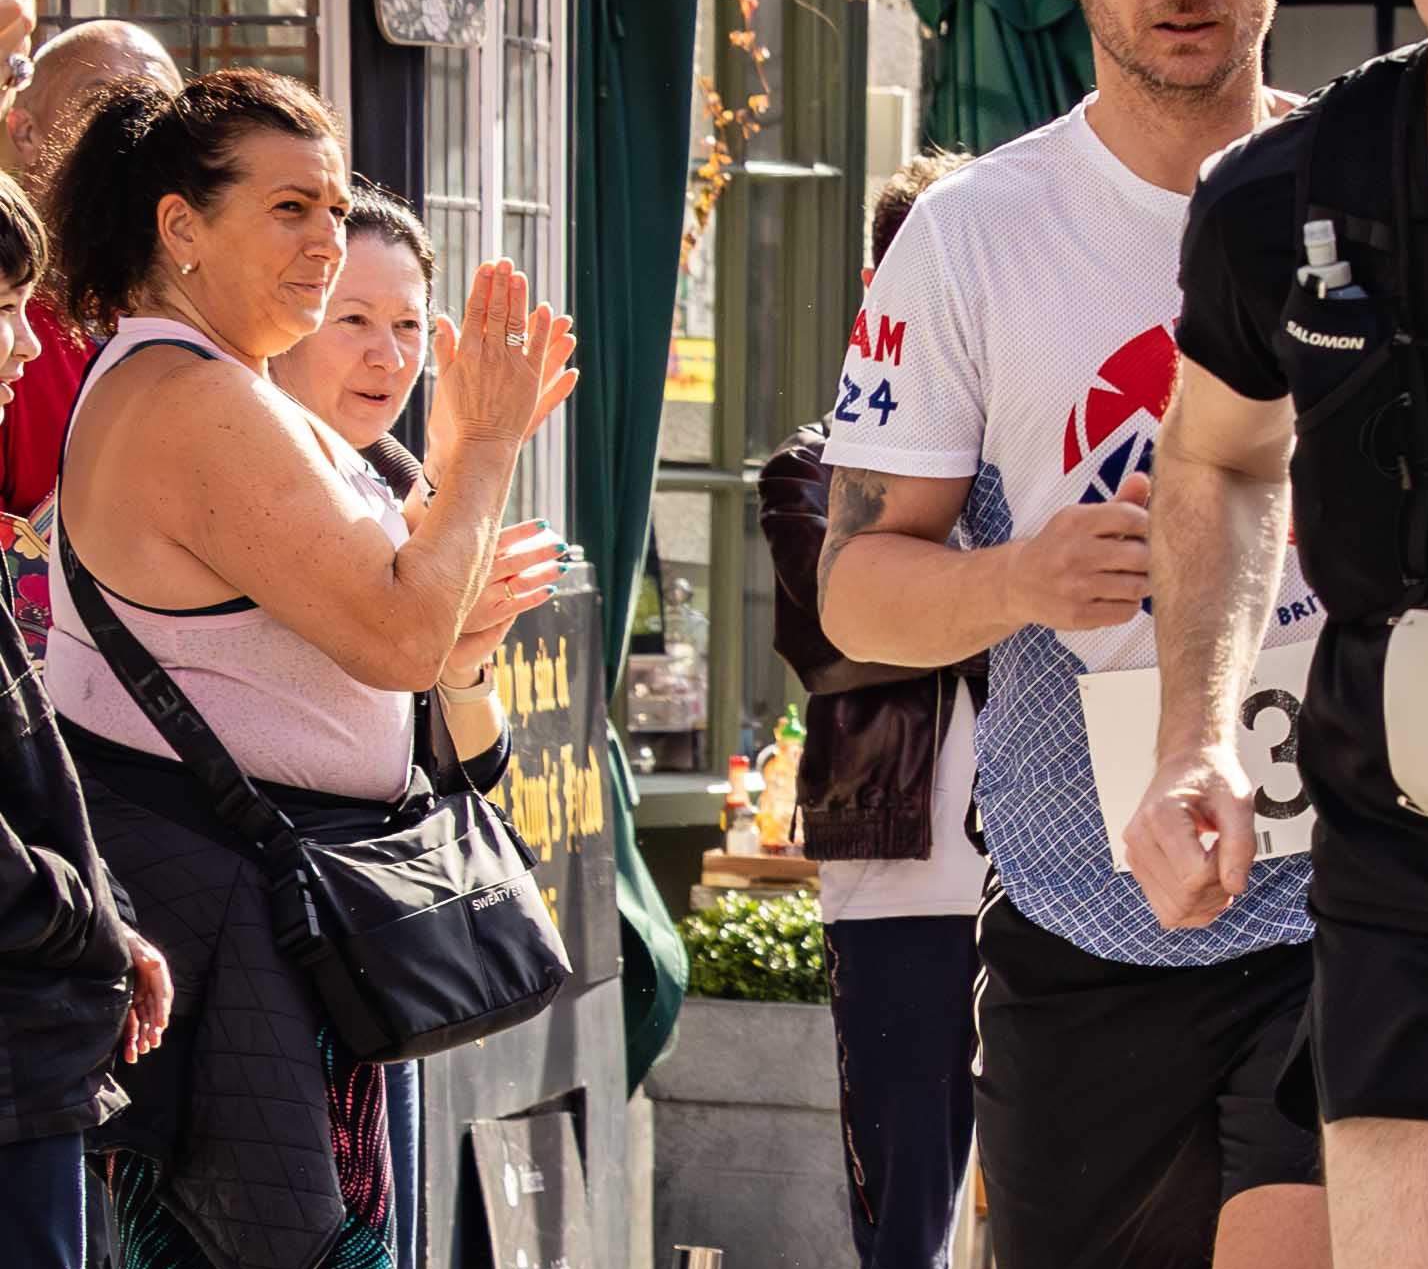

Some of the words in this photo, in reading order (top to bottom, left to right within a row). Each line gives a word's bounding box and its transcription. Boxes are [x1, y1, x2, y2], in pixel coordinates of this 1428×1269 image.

[1286, 320, 1366, 350] SALOMON
[1276, 592, 1317, 626] BRI
[471, 885, 511, 911] SWEATY
